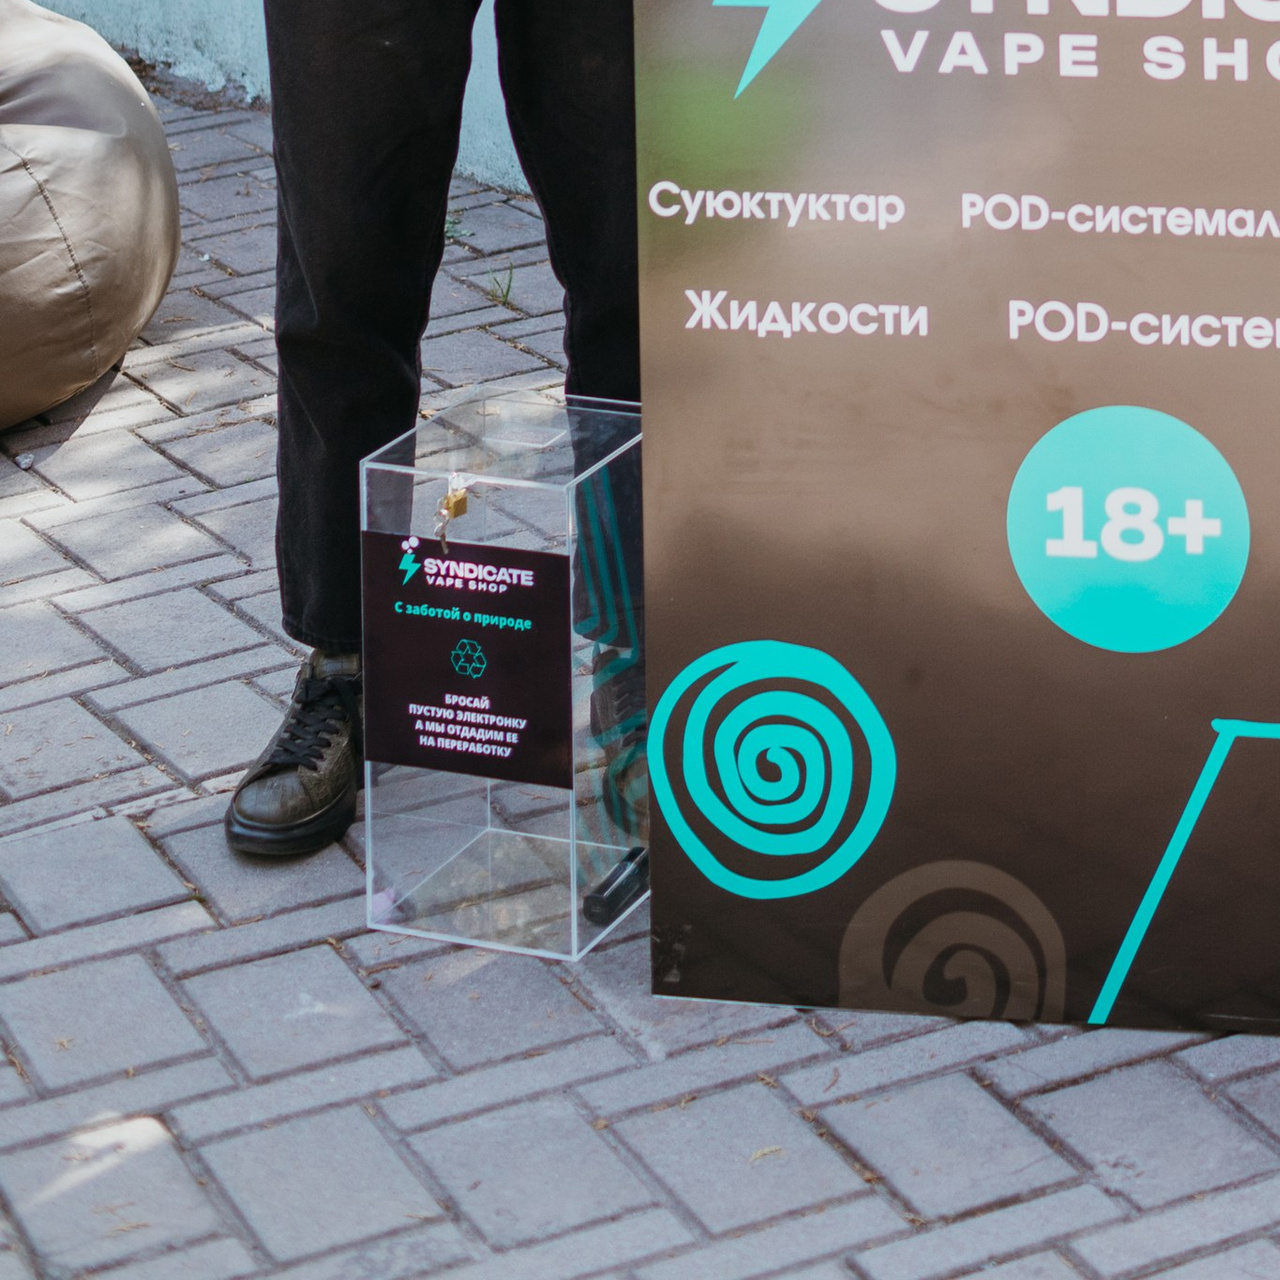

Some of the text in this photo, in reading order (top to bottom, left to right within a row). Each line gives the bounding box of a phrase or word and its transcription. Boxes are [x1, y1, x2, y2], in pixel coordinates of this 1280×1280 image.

[881, 29, 1099, 79] VAPE
[648, 181, 905, 226] Суюктуктар
[684, 288, 929, 338] Жидкости
[1044, 486, 1222, 563] 18+
[424, 558, 535, 587] SYNDICATE
[426, 576, 508, 594] VAPE SHOP
[394, 601, 532, 631] С заботой о природе
[445, 693, 490, 710] БРОСАЙ
[409, 703, 527, 730] ПУСТУЮ ЭЛЕКТРОНКУ
[415, 720, 519, 743] А МЫ ОТДАДИМ ЕЕ
[419, 735, 512, 758] НА ПЕРЕРАБОТКУ
